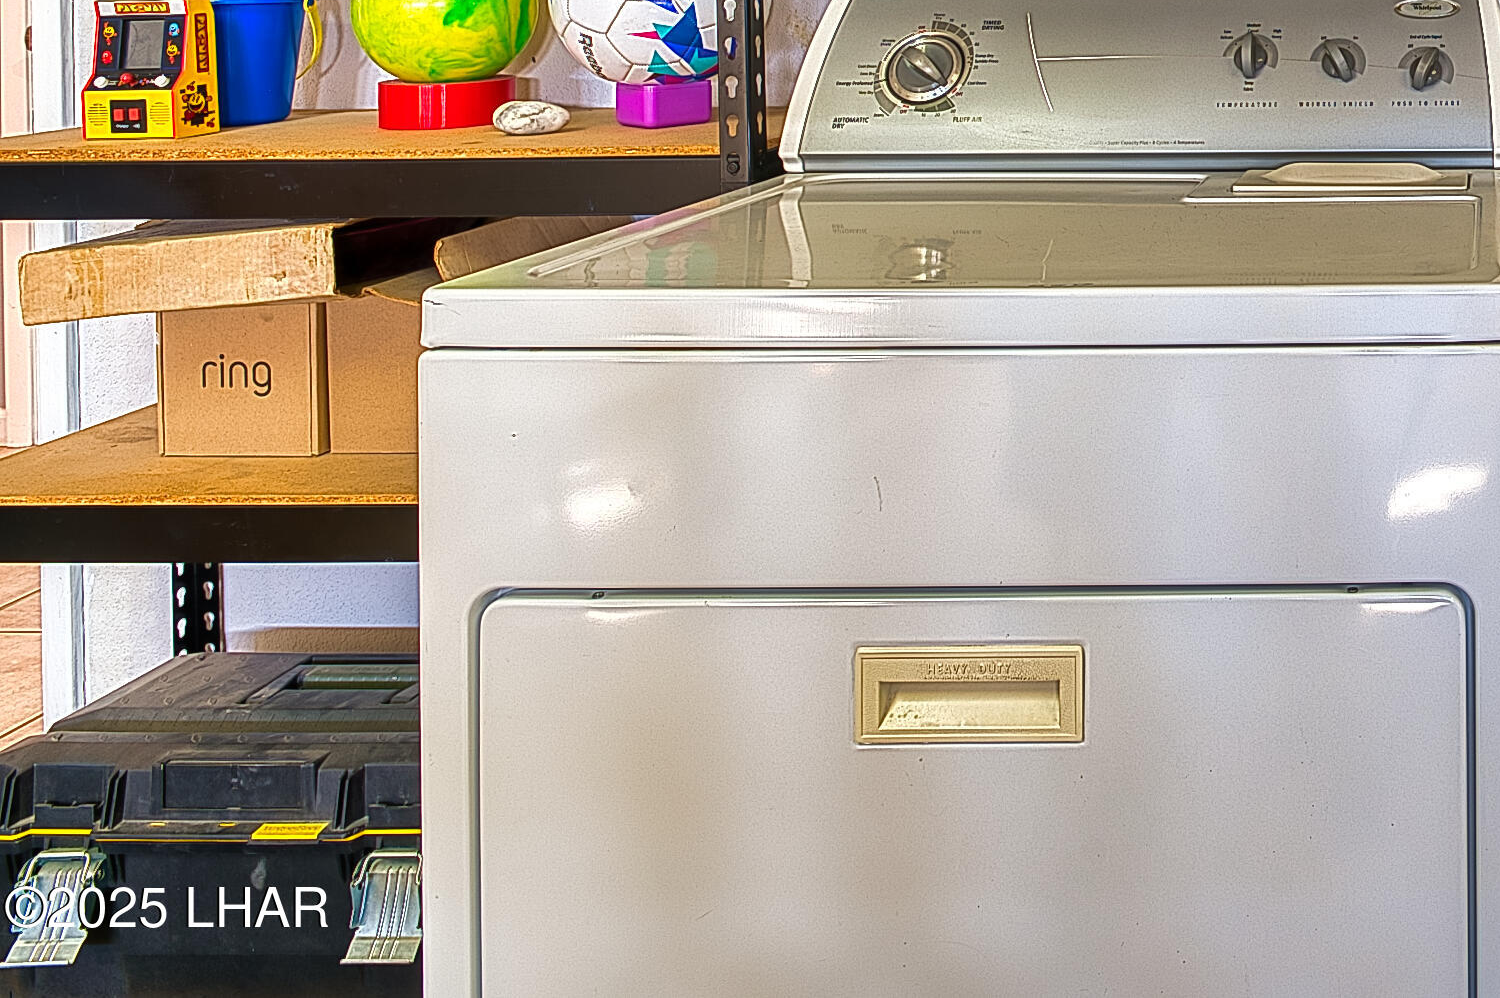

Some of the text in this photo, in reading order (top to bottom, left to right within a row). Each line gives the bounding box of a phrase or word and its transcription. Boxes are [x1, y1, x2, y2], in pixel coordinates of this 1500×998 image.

[1411, 3, 1442, 11] Whirlpool
[202, 354, 272, 397] ring
[927, 663, 1012, 674] HEAVY DUTY
